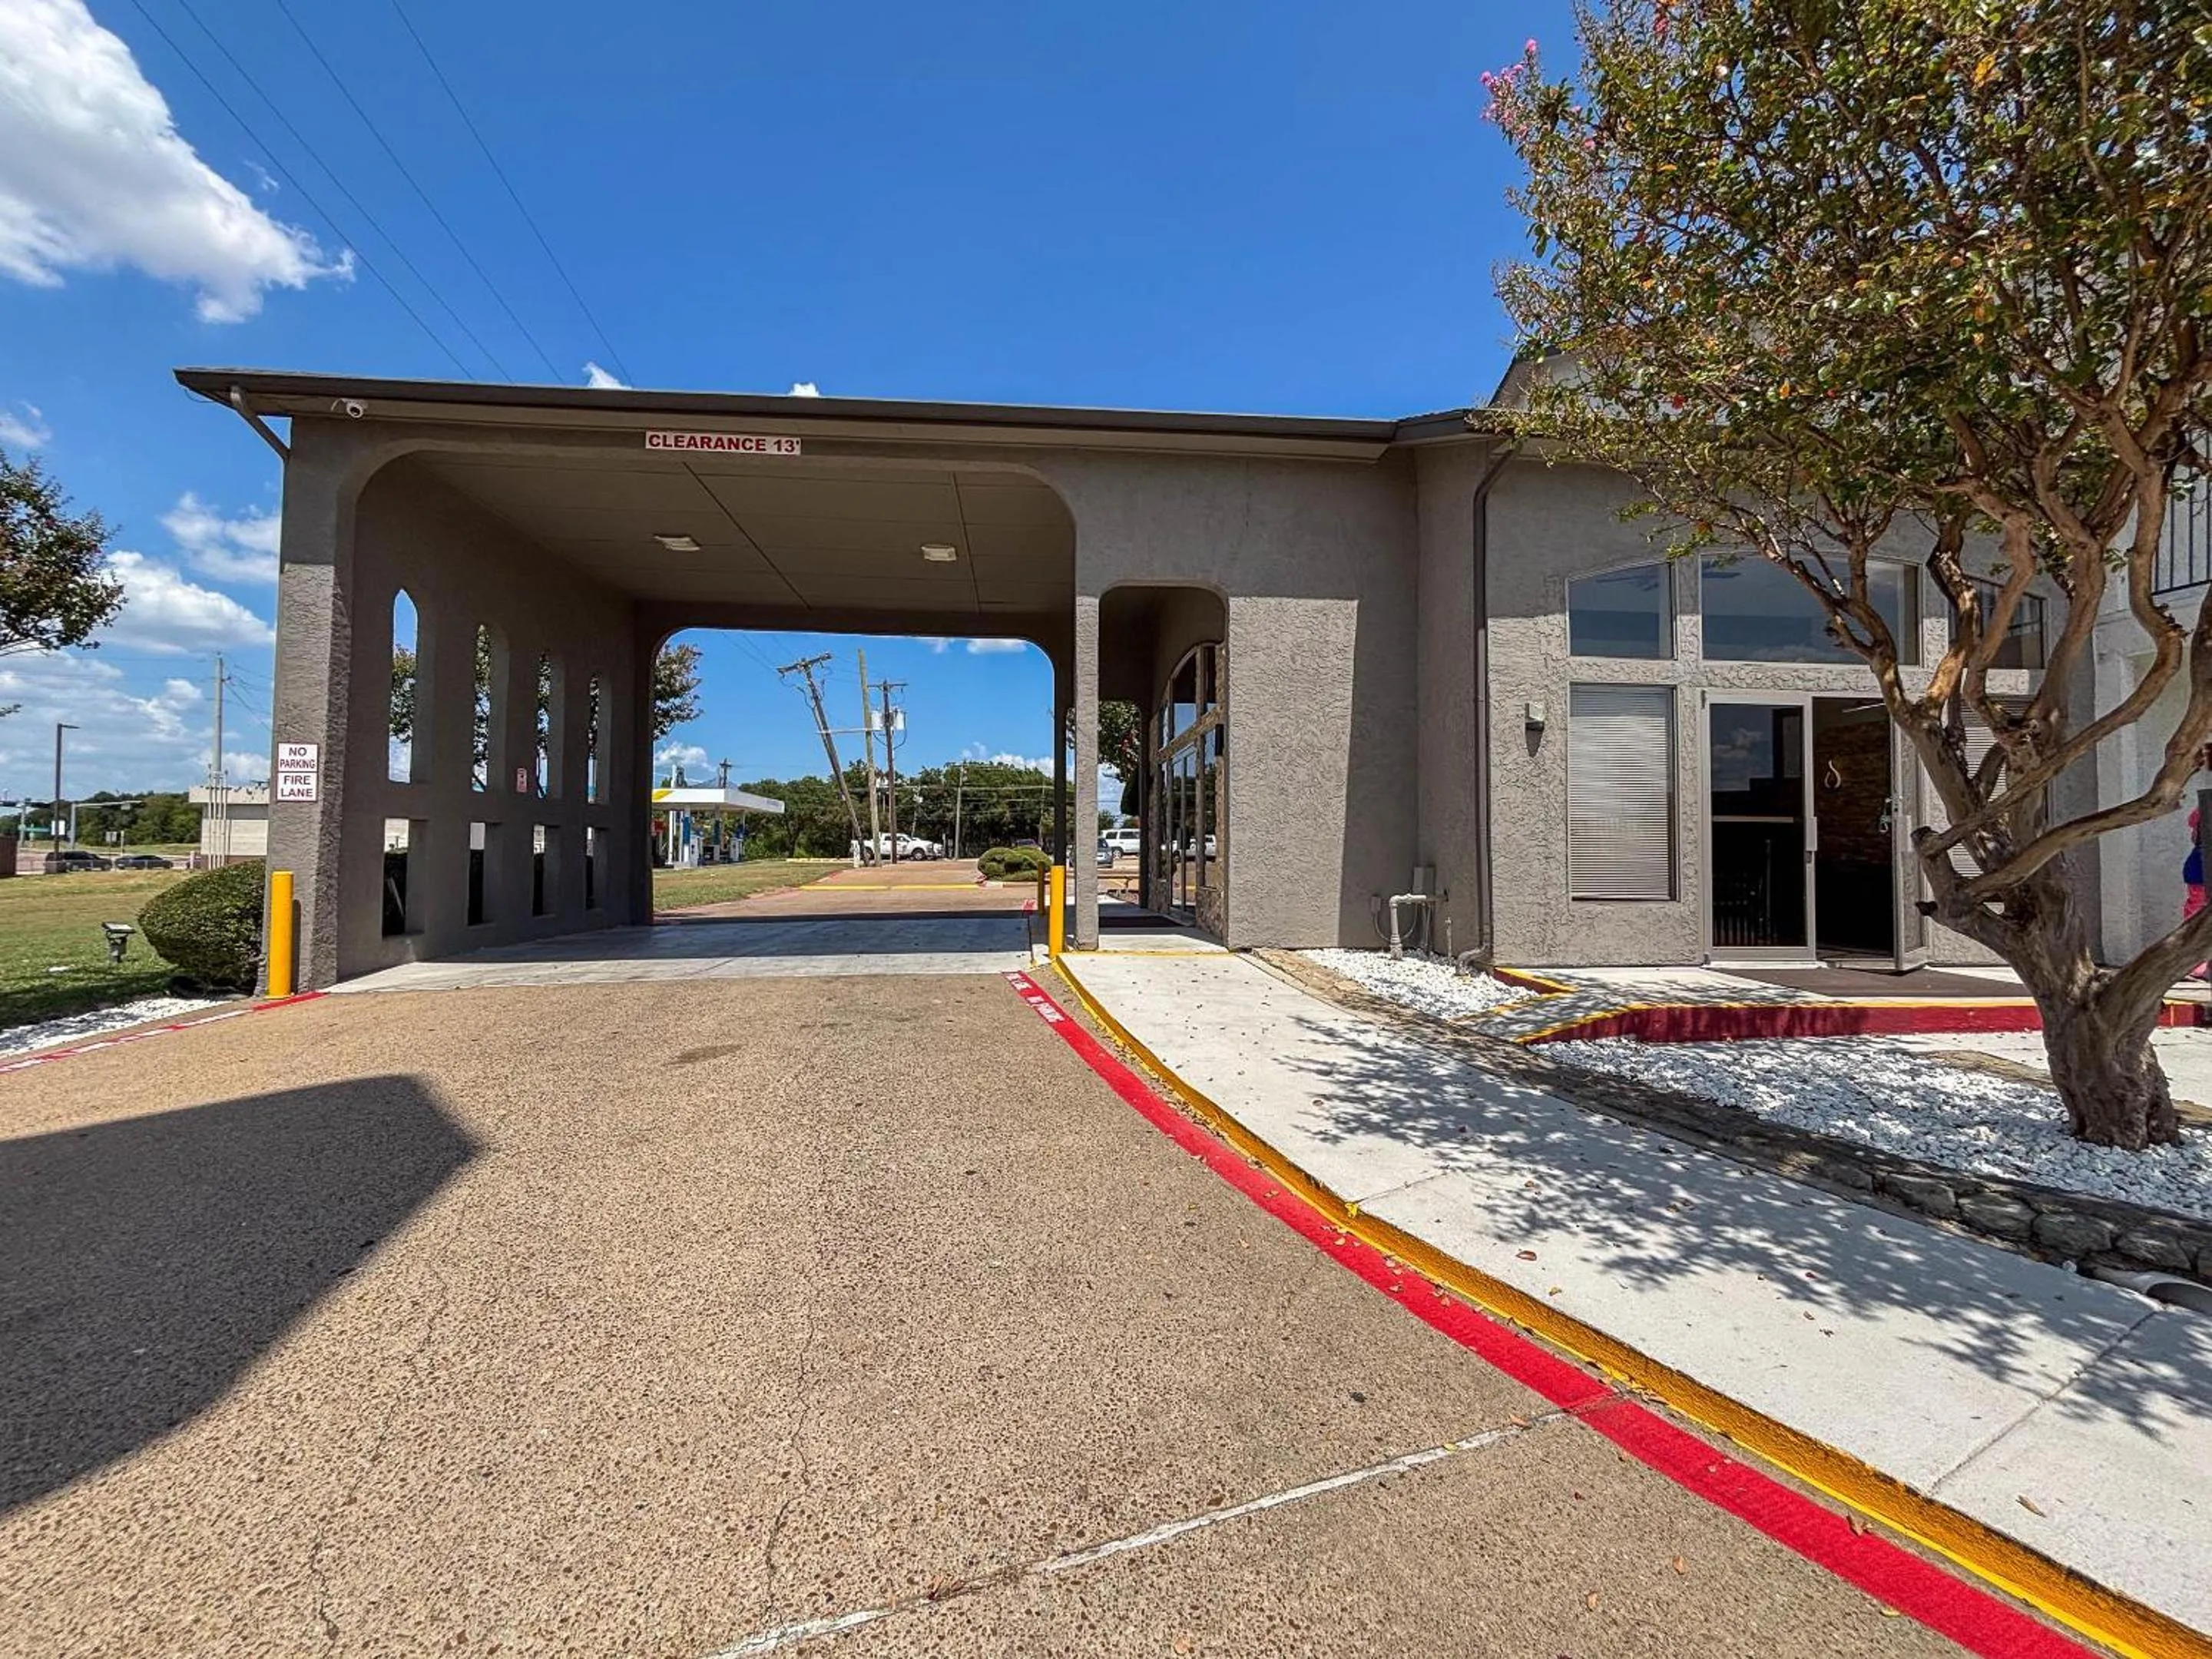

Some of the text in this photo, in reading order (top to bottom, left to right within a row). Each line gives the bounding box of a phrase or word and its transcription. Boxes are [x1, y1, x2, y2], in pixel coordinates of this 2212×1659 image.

[648, 434, 800, 453] CLEARANCE 13'
[289, 747, 307, 757] NO
[280, 759, 316, 769] PARKING
[284, 775, 311, 785] FIRE
[281, 787, 313, 797] LANE
